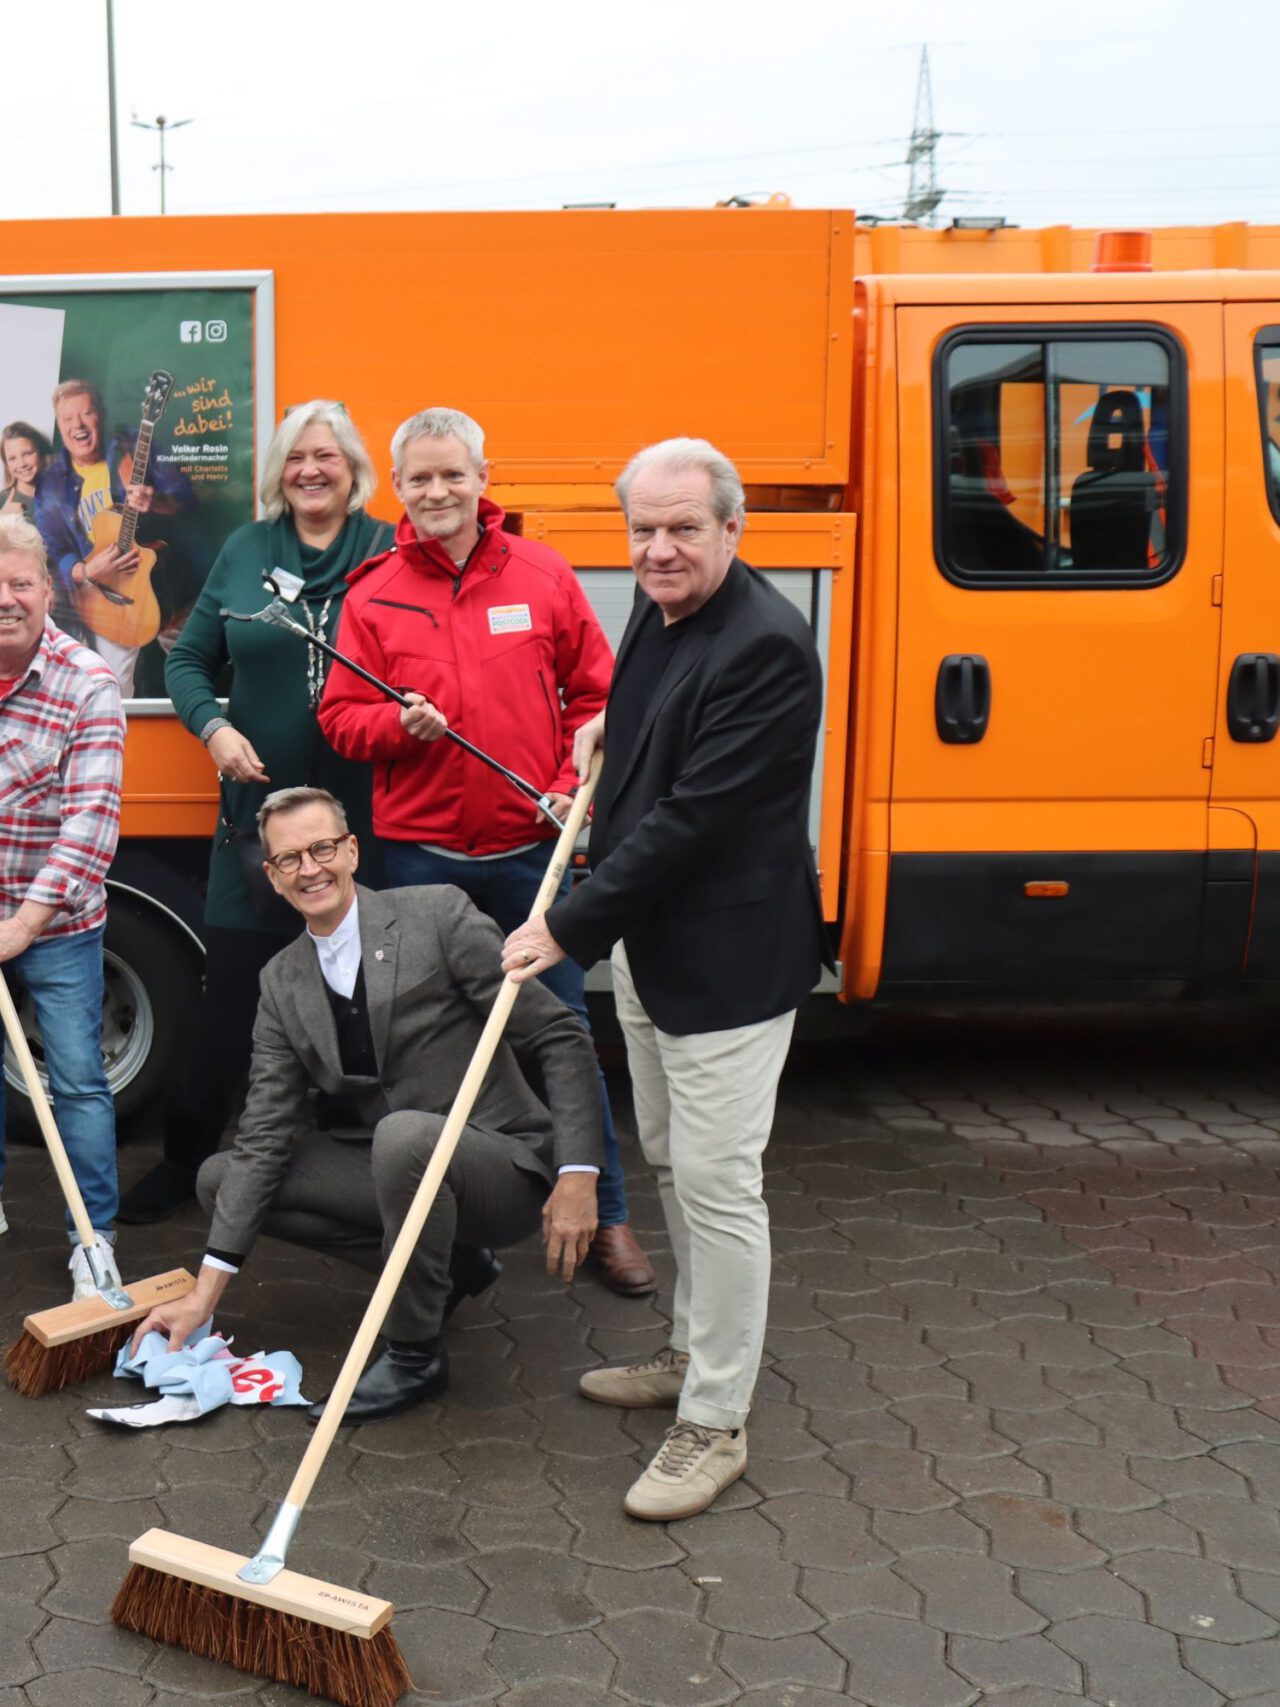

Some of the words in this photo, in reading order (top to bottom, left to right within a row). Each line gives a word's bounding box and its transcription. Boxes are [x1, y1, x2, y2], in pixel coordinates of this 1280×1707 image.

[192, 389, 233, 412] sind
[174, 411, 233, 436] dabei!
[172, 445, 201, 454] Volker
[203, 443, 229, 453] Rosin
[156, 453, 229, 462] Kinderliedermacher
